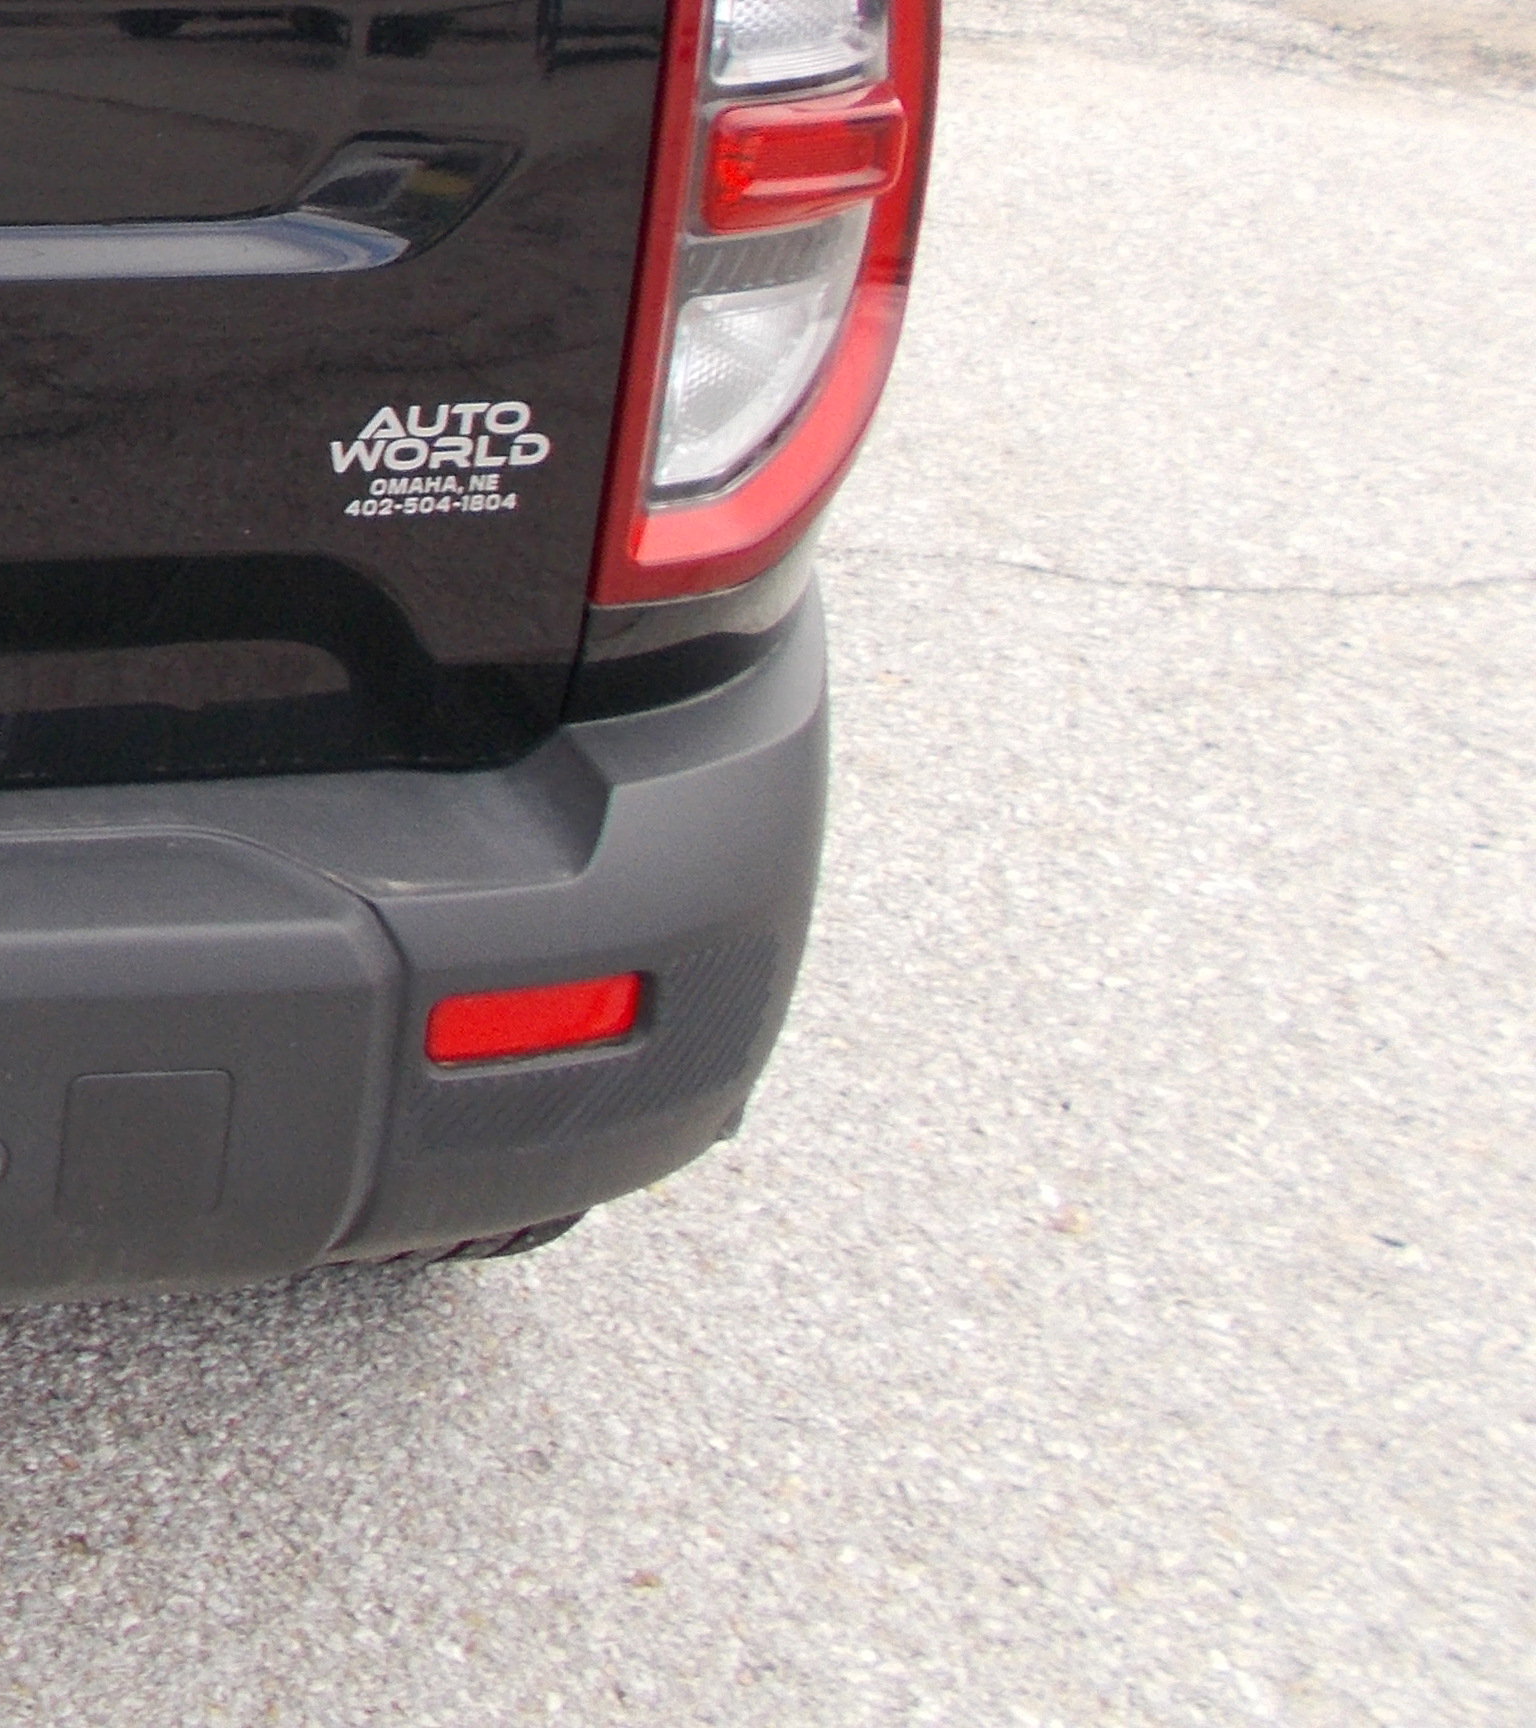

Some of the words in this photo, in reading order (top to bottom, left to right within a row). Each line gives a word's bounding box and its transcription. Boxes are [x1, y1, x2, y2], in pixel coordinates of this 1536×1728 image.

[357, 400, 531, 440] AUTO
[329, 432, 551, 473] WORLD
[369, 474, 463, 496] OMAHA,
[468, 473, 500, 491] NE
[344, 492, 518, 517] 402-504-1804
